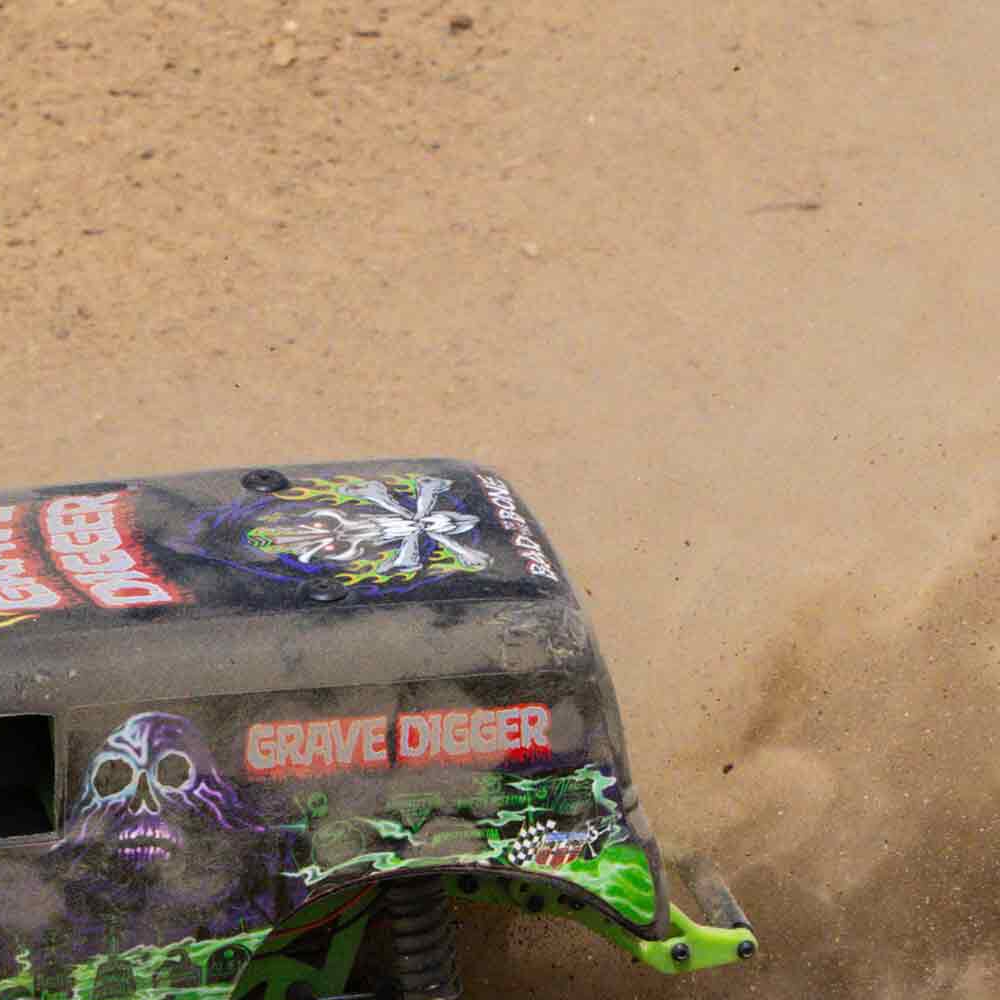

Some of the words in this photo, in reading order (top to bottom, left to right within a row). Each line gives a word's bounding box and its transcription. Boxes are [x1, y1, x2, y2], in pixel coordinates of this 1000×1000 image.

[46, 493, 172, 604] DIGGER
[247, 715, 388, 769] GRAVE
[400, 706, 549, 757] DIGGER
